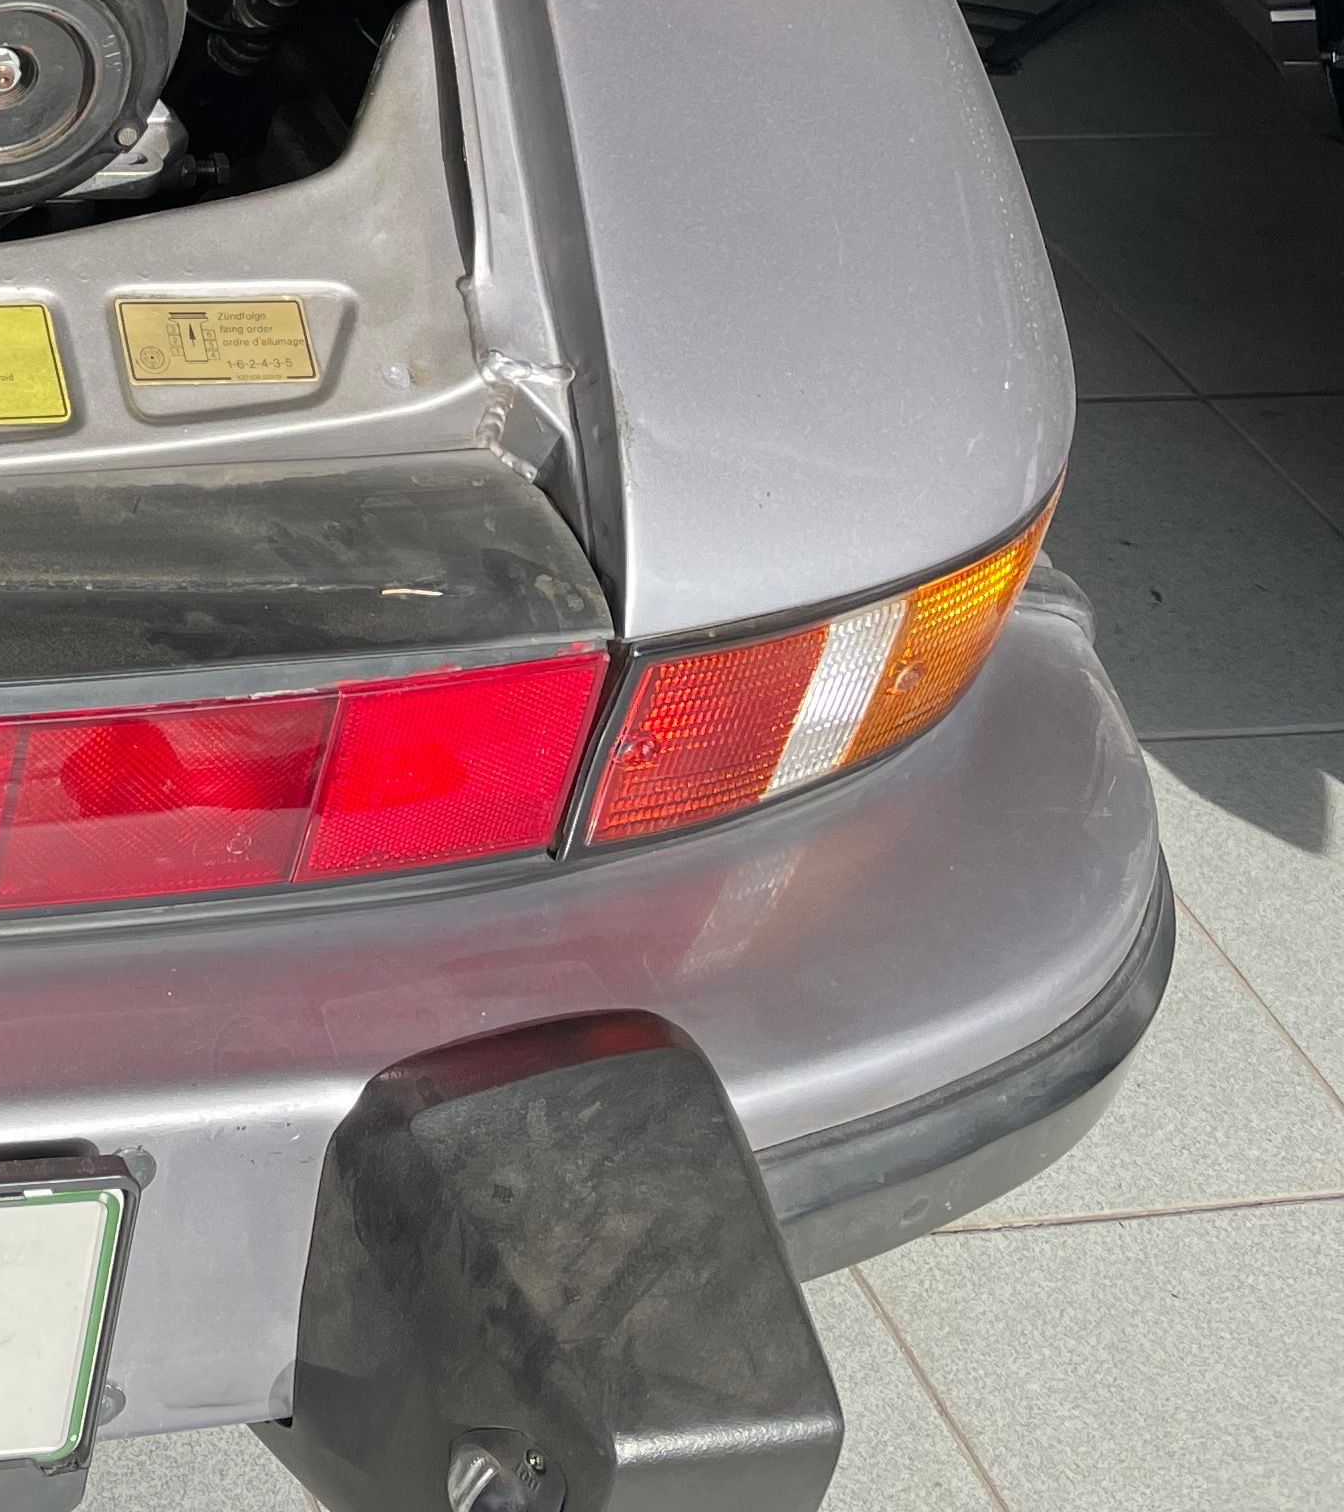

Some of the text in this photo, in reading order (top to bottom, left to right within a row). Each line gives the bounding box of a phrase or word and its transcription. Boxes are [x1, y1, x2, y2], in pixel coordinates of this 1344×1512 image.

[217, 311, 267, 321] Zündfolge
[220, 324, 273, 335] firing order
[222, 336, 305, 347] ordre d'allumage
[226, 358, 293, 369] 1-6-2-4-3-5
